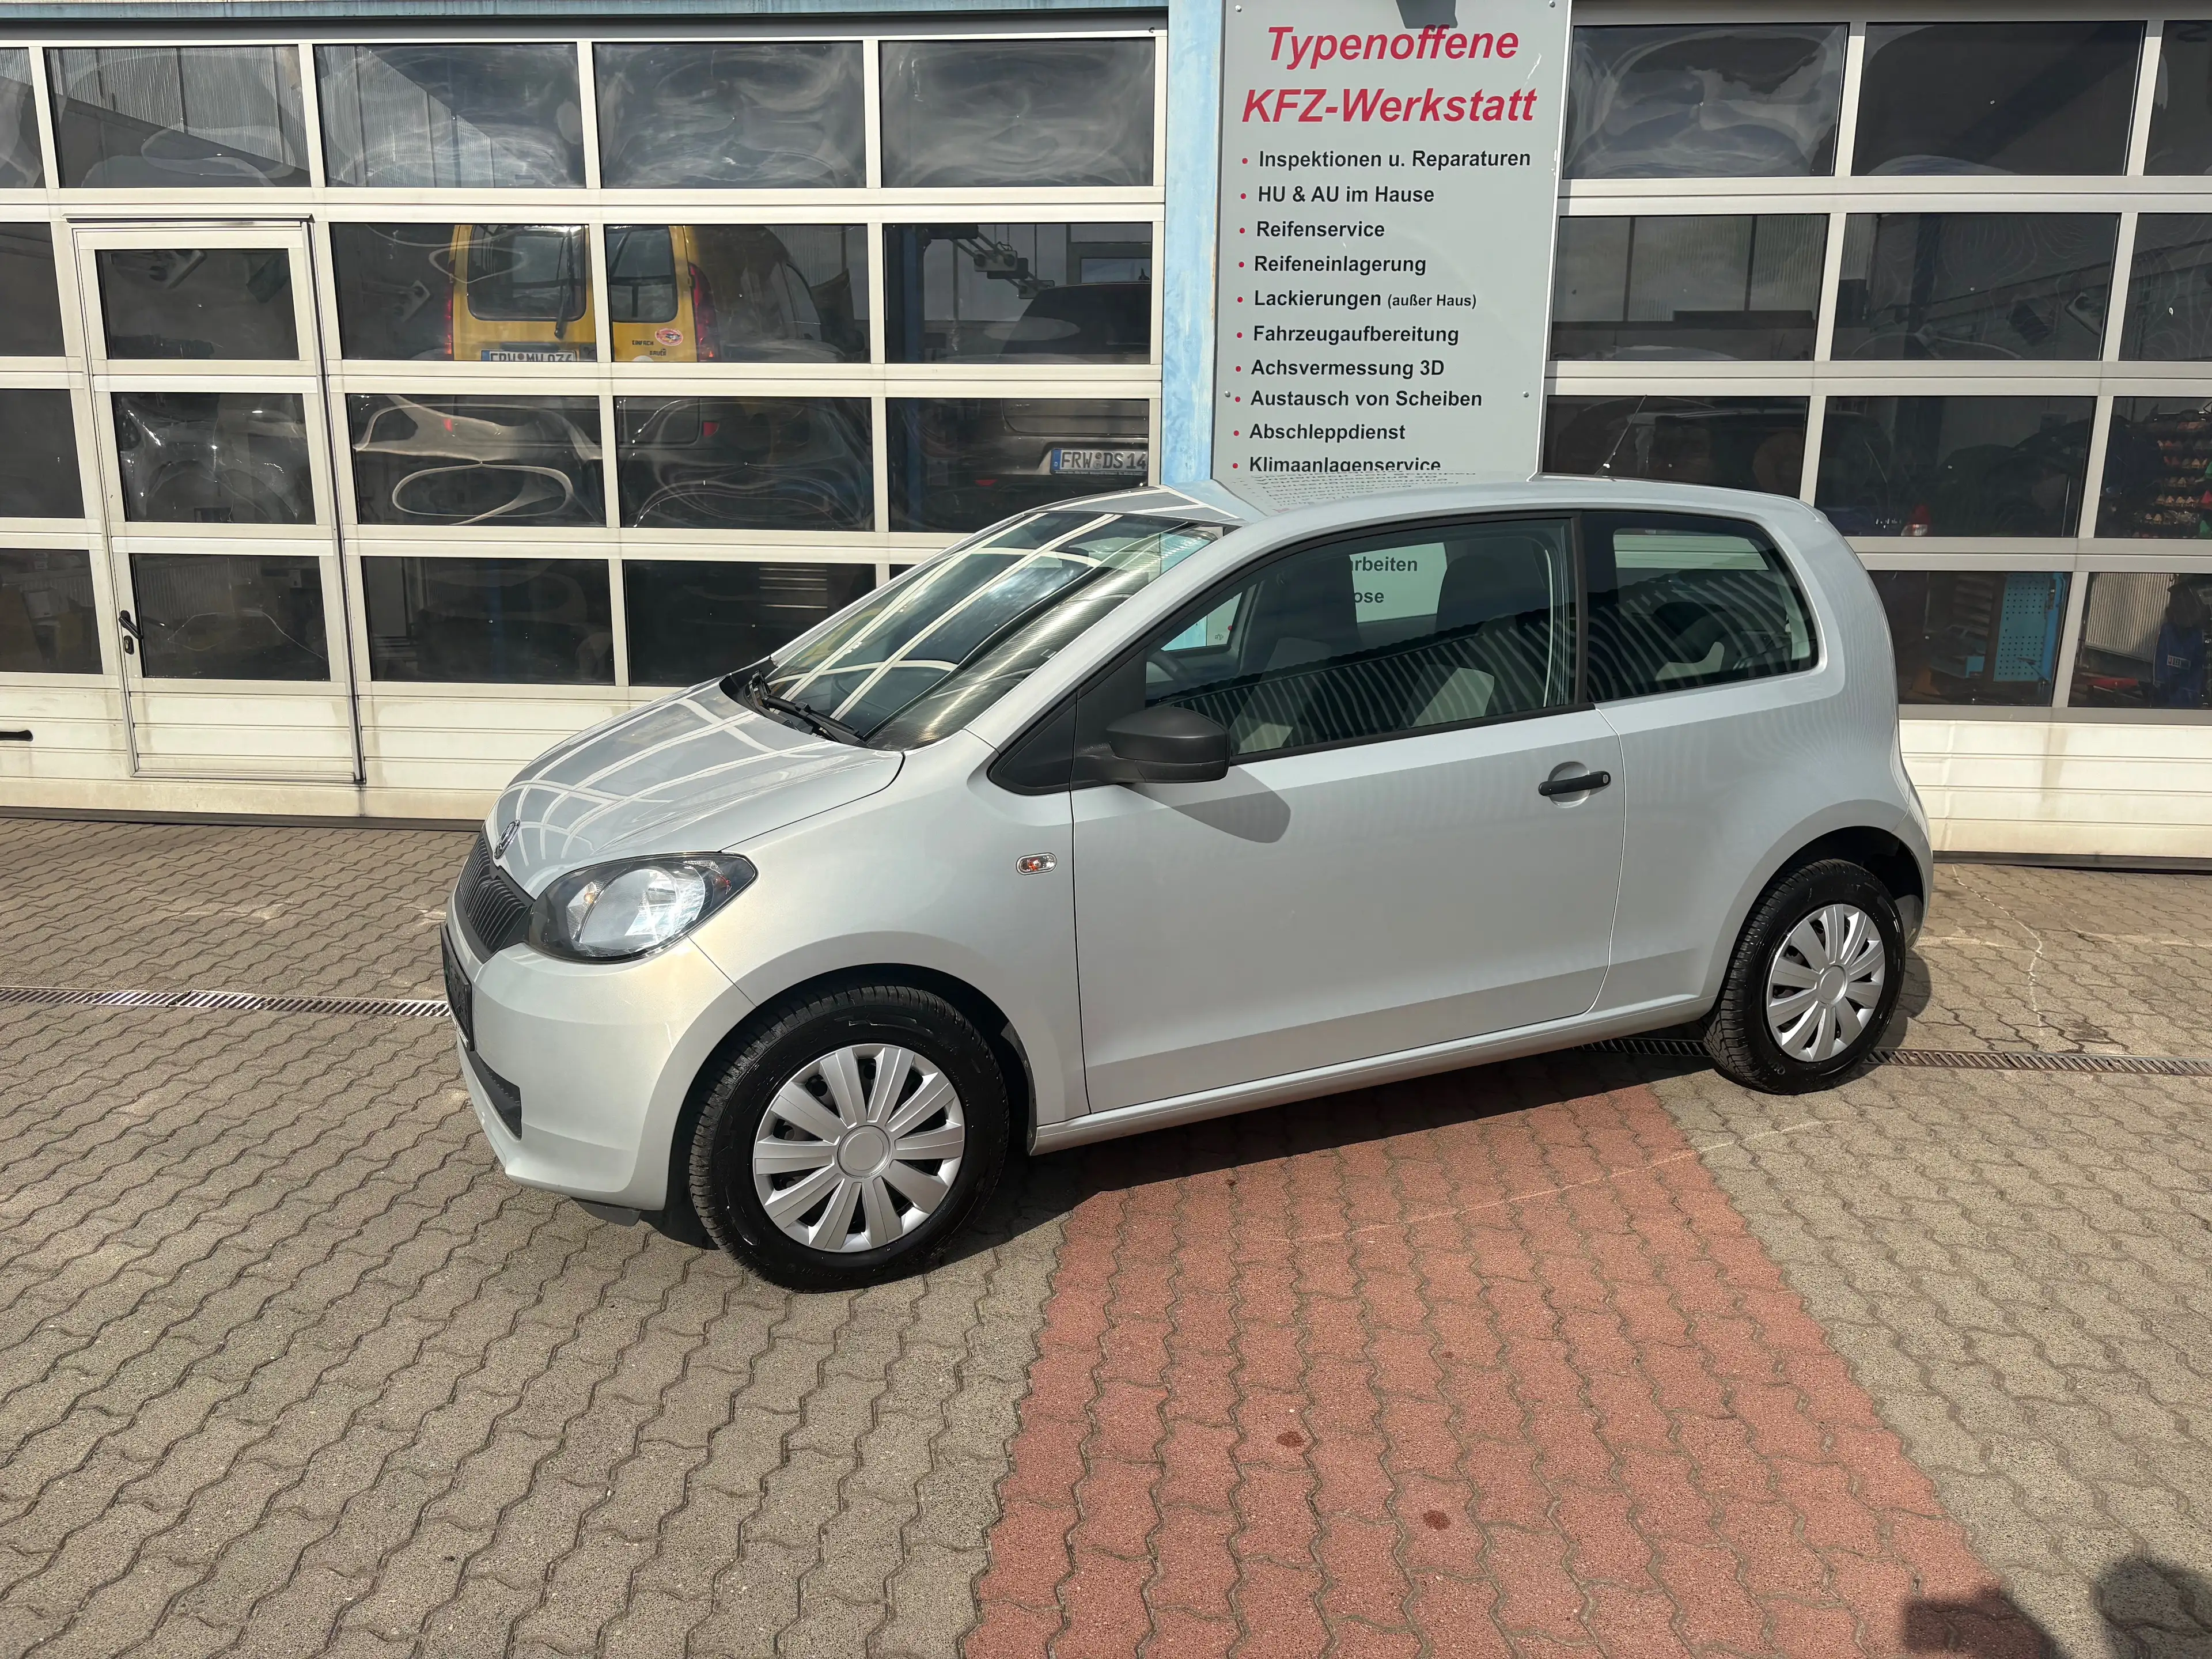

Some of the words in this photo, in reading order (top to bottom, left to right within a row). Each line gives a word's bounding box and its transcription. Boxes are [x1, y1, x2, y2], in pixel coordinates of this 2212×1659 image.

[1268, 24, 1519, 70] Typenoffene
[1243, 88, 1537, 123] KFZ-Werkstatt
[1259, 150, 1381, 171] Inspektionen
[1389, 154, 1405, 167] u.
[1412, 150, 1531, 171] Reparaturen
[1258, 186, 1285, 202] HU
[1292, 186, 1306, 202] &
[1310, 186, 1339, 202] AU
[1346, 186, 1368, 202] im
[1375, 186, 1434, 202] Hause
[1257, 221, 1385, 237] Reifenservice
[1255, 255, 1426, 276] Reifeneinlagerung
[1255, 290, 1381, 310] Lackierungen
[1388, 294, 1433, 309] (außer
[1436, 294, 1476, 310] Haus)
[1253, 325, 1459, 346] Fahrzeugaufbereitung
[1251, 359, 1414, 380] Achsvermessung
[1420, 359, 1444, 376] 3D
[1250, 390, 1349, 406] Austausch
[1355, 394, 1389, 406] von
[1396, 390, 1482, 406] Scheiben
[1249, 423, 1406, 444] Abschleppdienst
[1062, 452, 1093, 468] FRW
[1103, 452, 1123, 468] DS
[1249, 456, 1441, 472] Klimaanlagenservice
